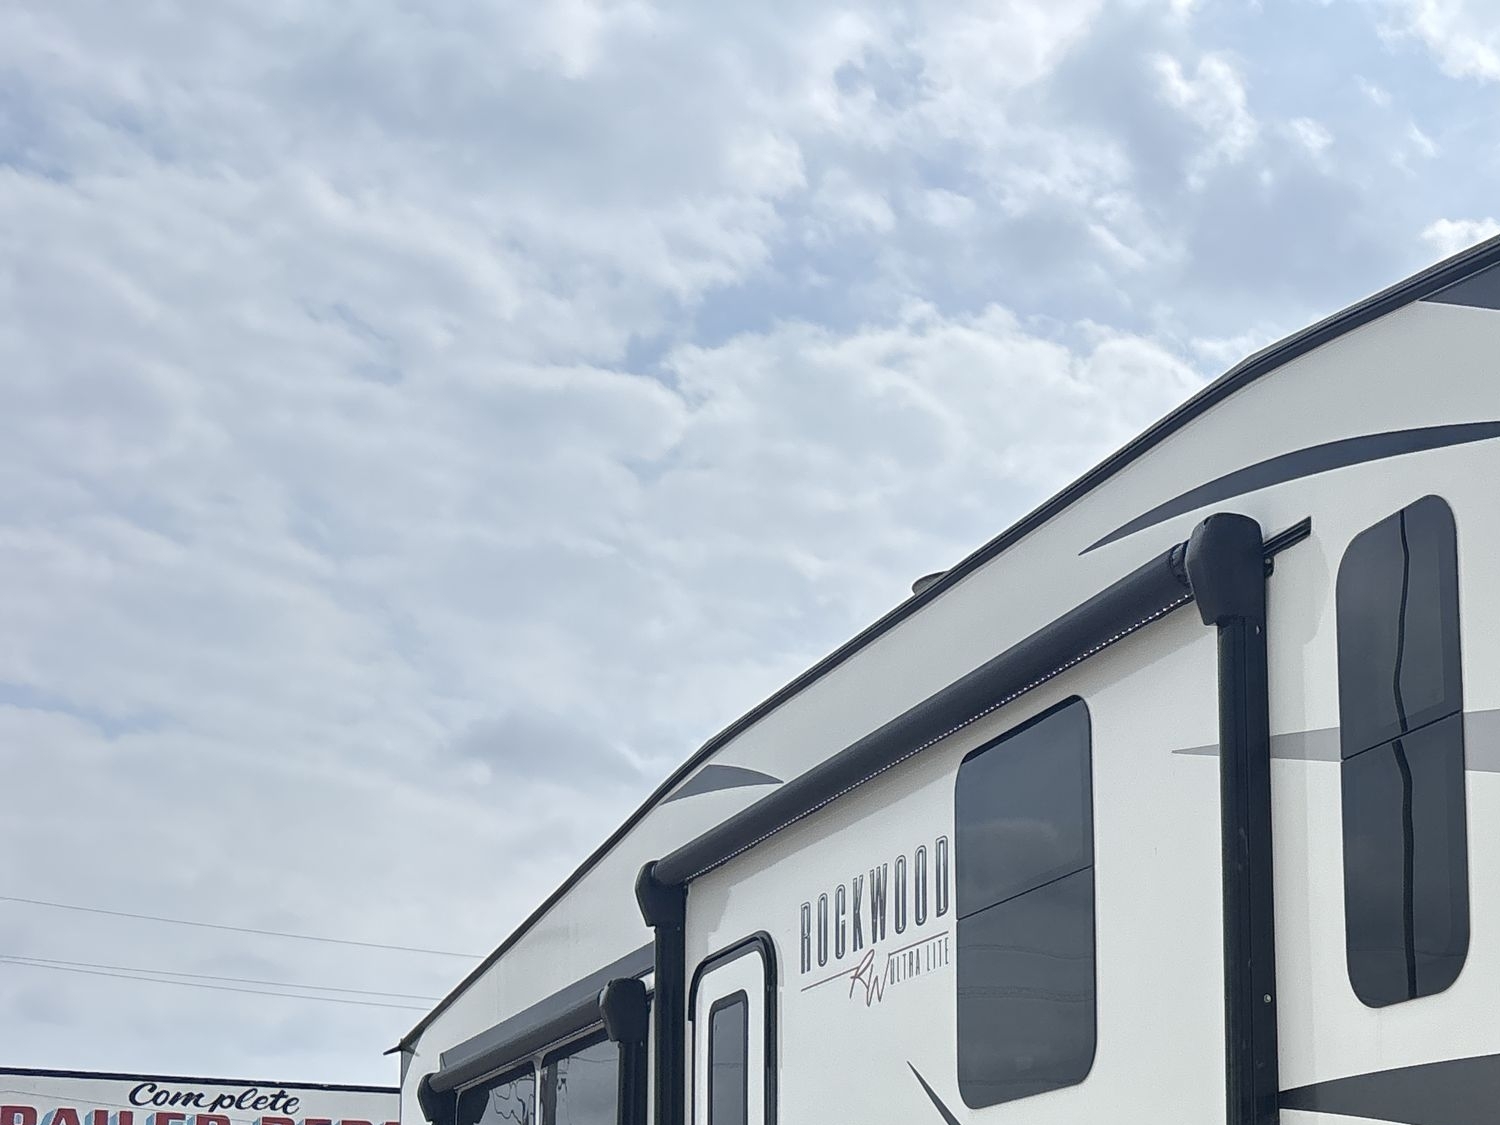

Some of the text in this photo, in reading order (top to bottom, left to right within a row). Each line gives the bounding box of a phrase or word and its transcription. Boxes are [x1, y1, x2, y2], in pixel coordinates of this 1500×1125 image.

[800, 835, 949, 974] ROCKWOOD
[890, 948, 921, 985] ULTRA
[926, 937, 949, 972] LITE
[128, 1082, 300, 1115] Complete
